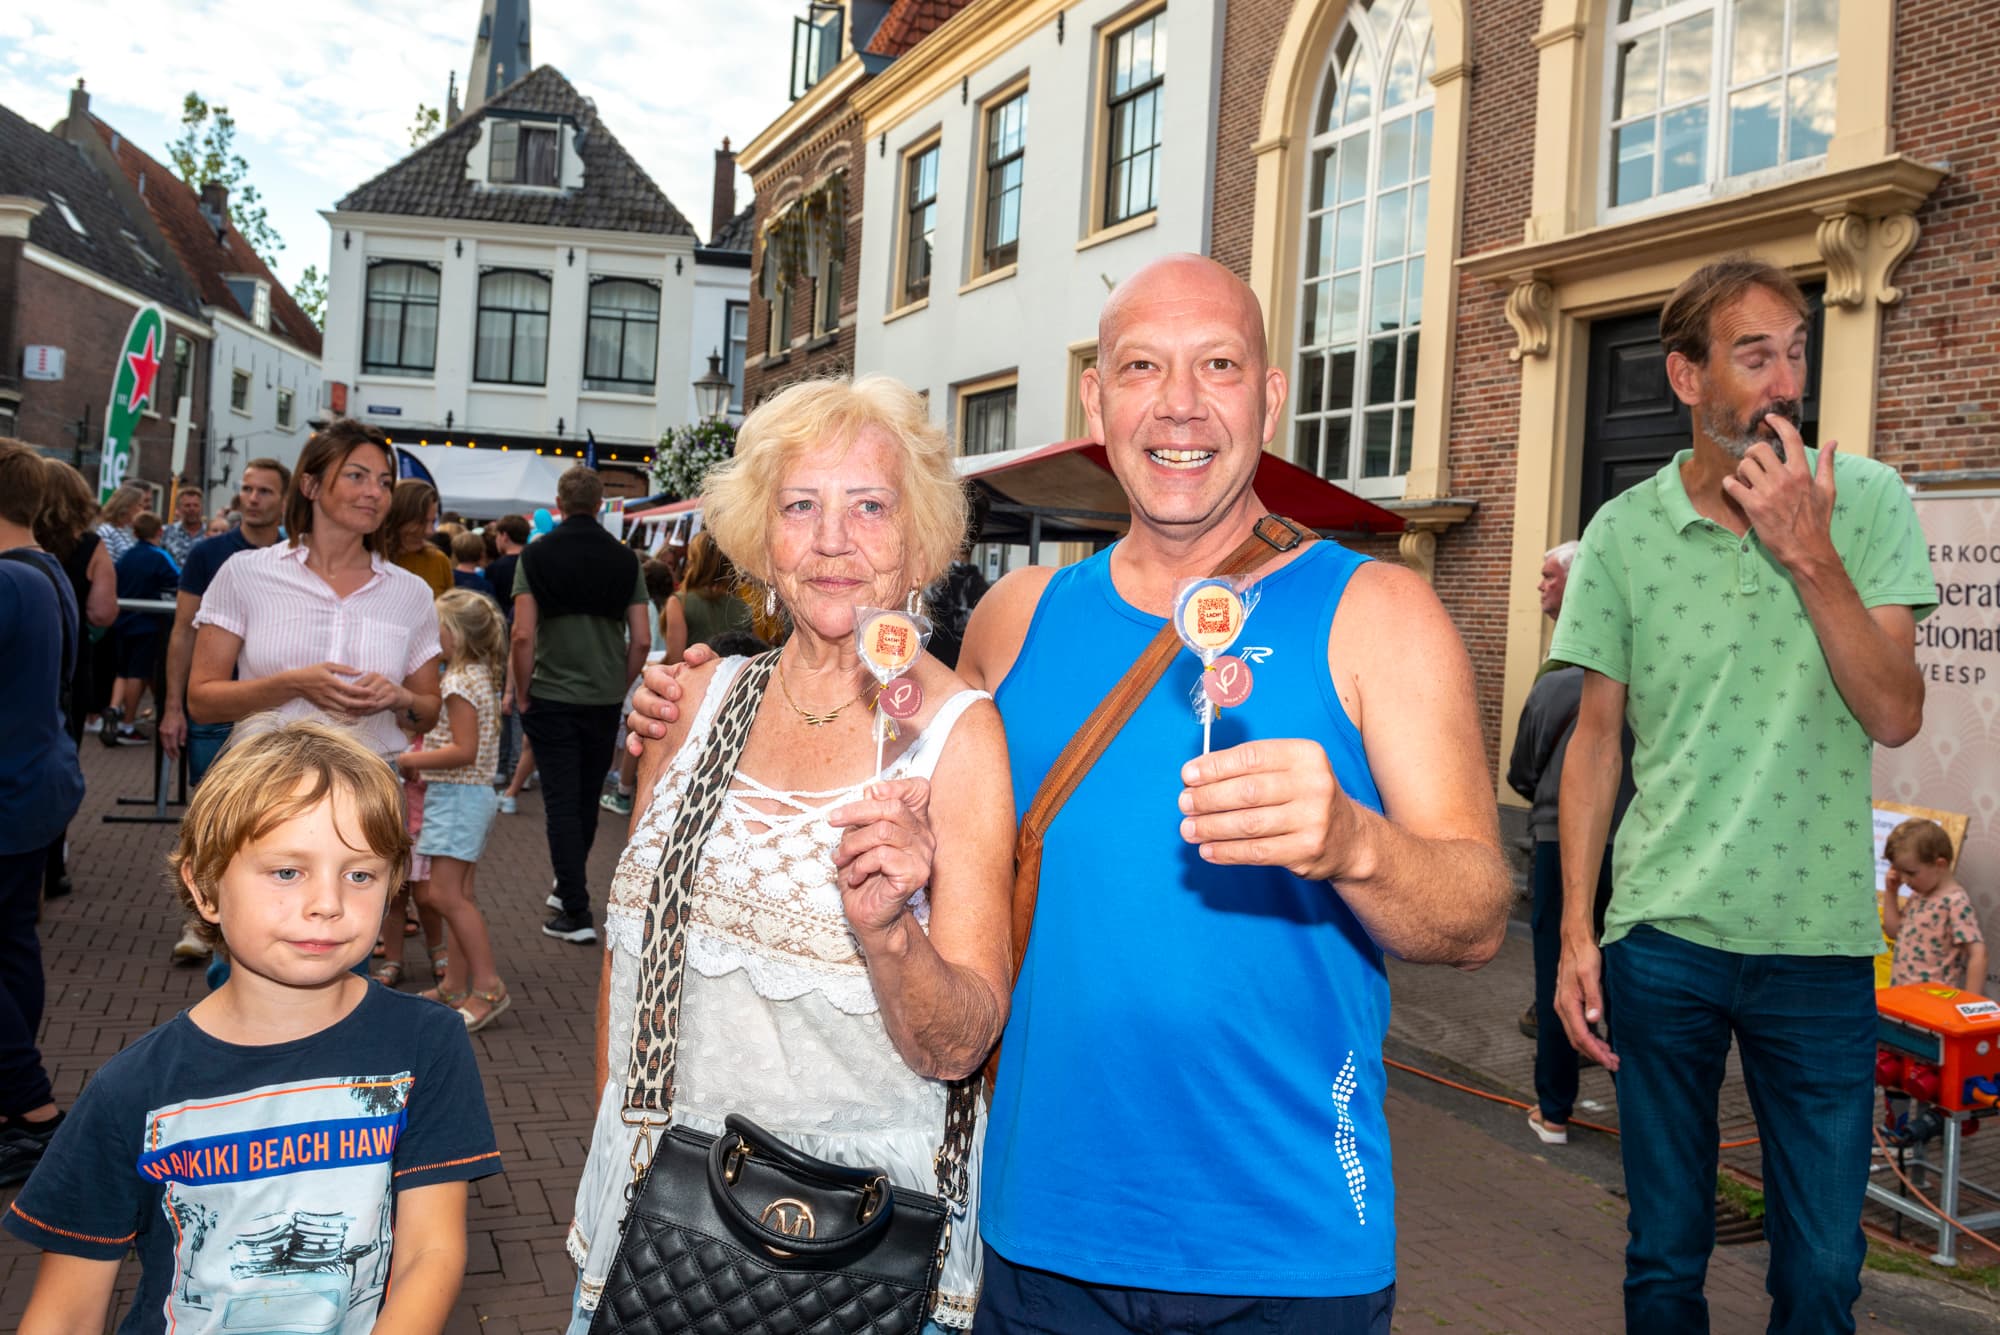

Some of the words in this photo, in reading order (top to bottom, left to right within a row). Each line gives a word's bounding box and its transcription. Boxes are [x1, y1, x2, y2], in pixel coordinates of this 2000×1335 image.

[143, 1144, 239, 1181] WAIKIKI
[249, 1131, 330, 1172] BEACH
[339, 1123, 399, 1160] HAW
